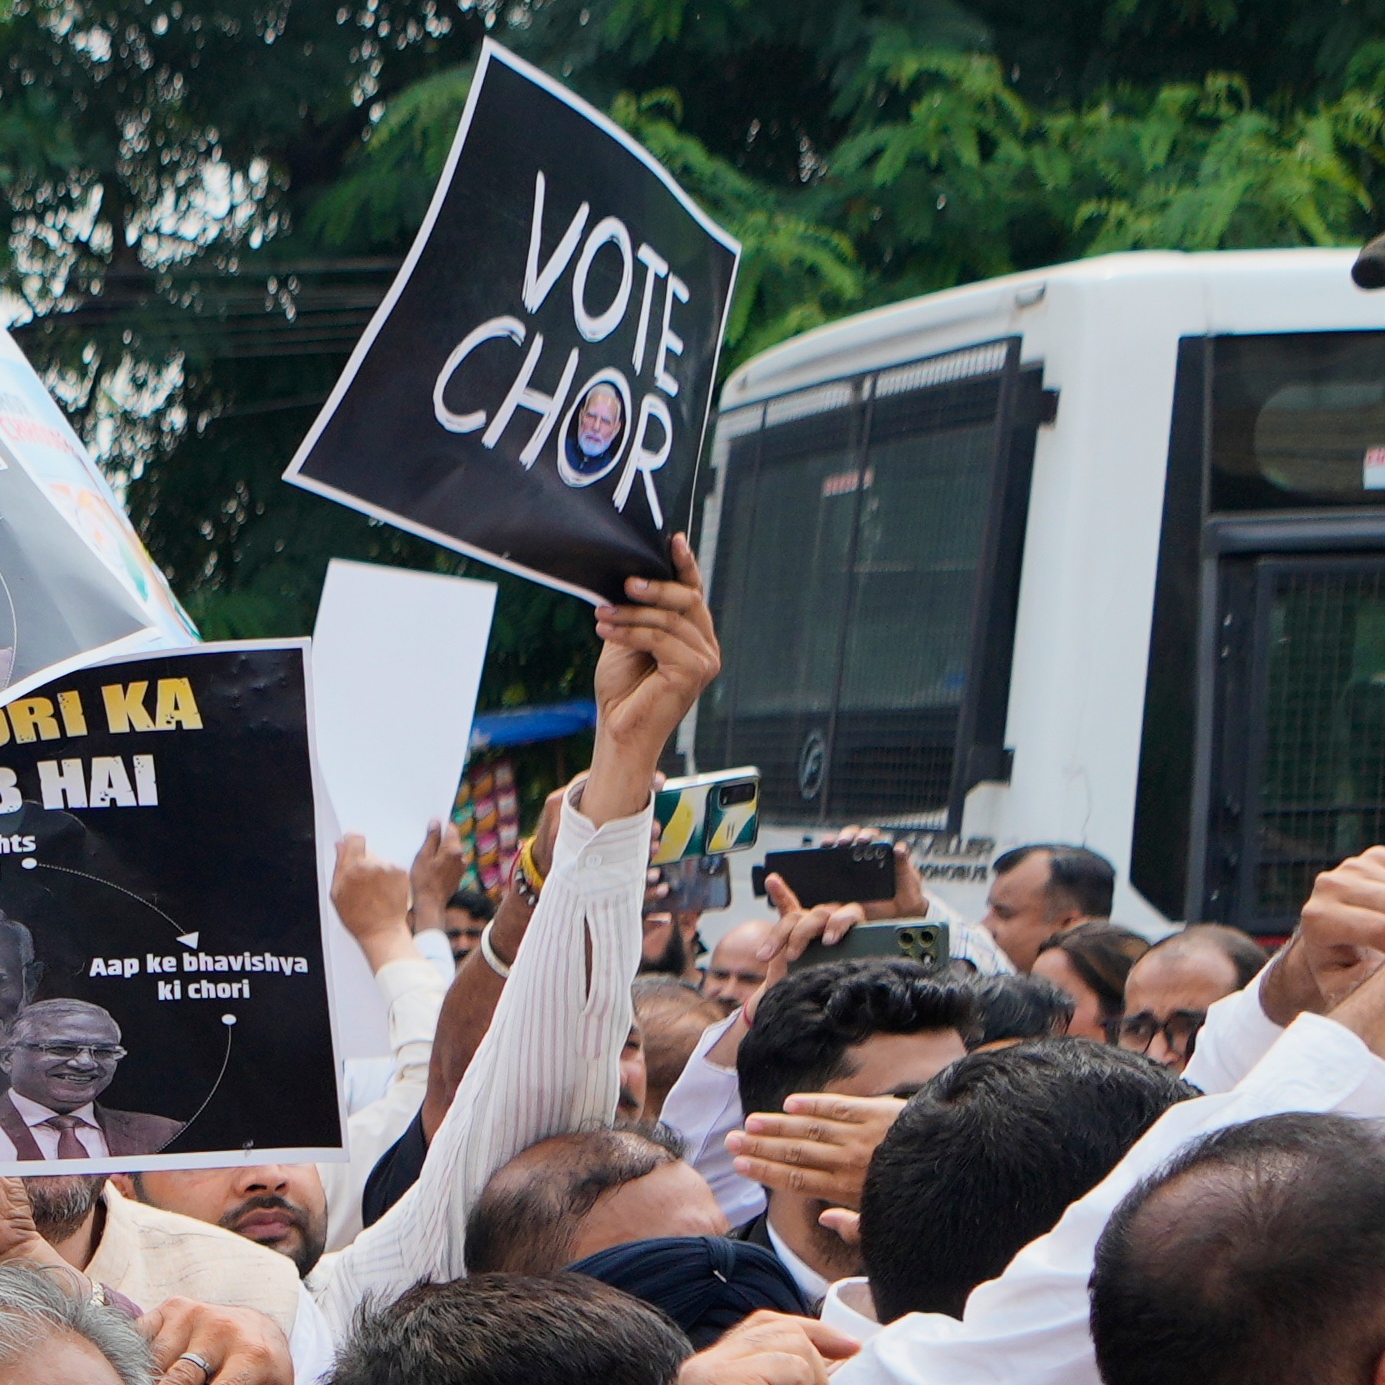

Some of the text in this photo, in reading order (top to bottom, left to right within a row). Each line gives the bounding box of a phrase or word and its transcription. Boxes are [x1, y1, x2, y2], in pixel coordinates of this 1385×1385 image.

[522, 170, 690, 397] VOTE
[432, 315, 673, 530] CHOR
[101, 677, 203, 734] KA
[37, 754, 158, 810] HAI
[89, 951, 308, 978] Aap ke bhavishya
[158, 979, 251, 1000] ki chori
